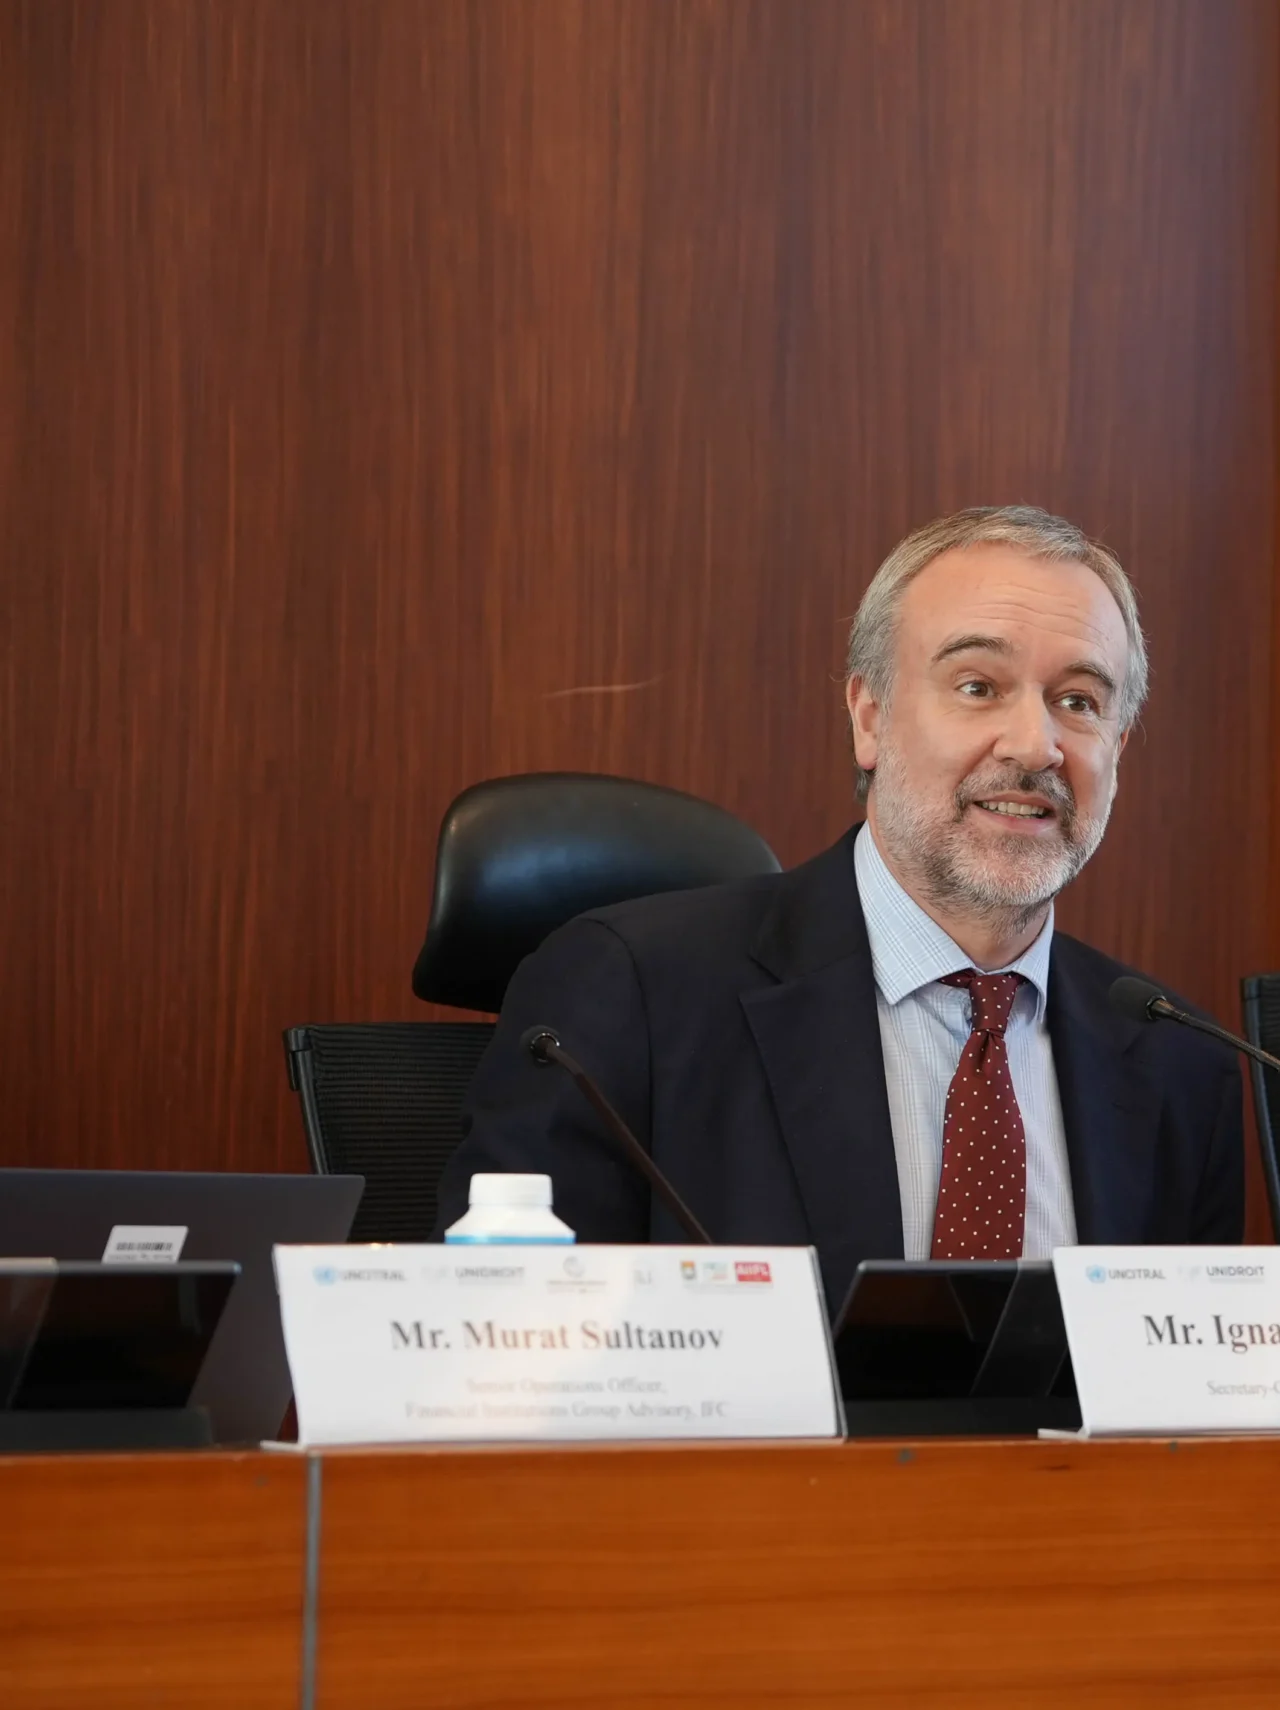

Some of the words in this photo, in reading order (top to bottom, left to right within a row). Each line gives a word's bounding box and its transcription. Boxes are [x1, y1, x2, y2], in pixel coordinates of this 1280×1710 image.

[1108, 1268, 1166, 1280] UNCITRAL
[1206, 1265, 1265, 1277] UNIDROIT
[391, 1320, 451, 1350] Mr.
[463, 1320, 571, 1350] Murat
[581, 1320, 724, 1351] Sultanov
[1144, 1315, 1203, 1346] Mr.
